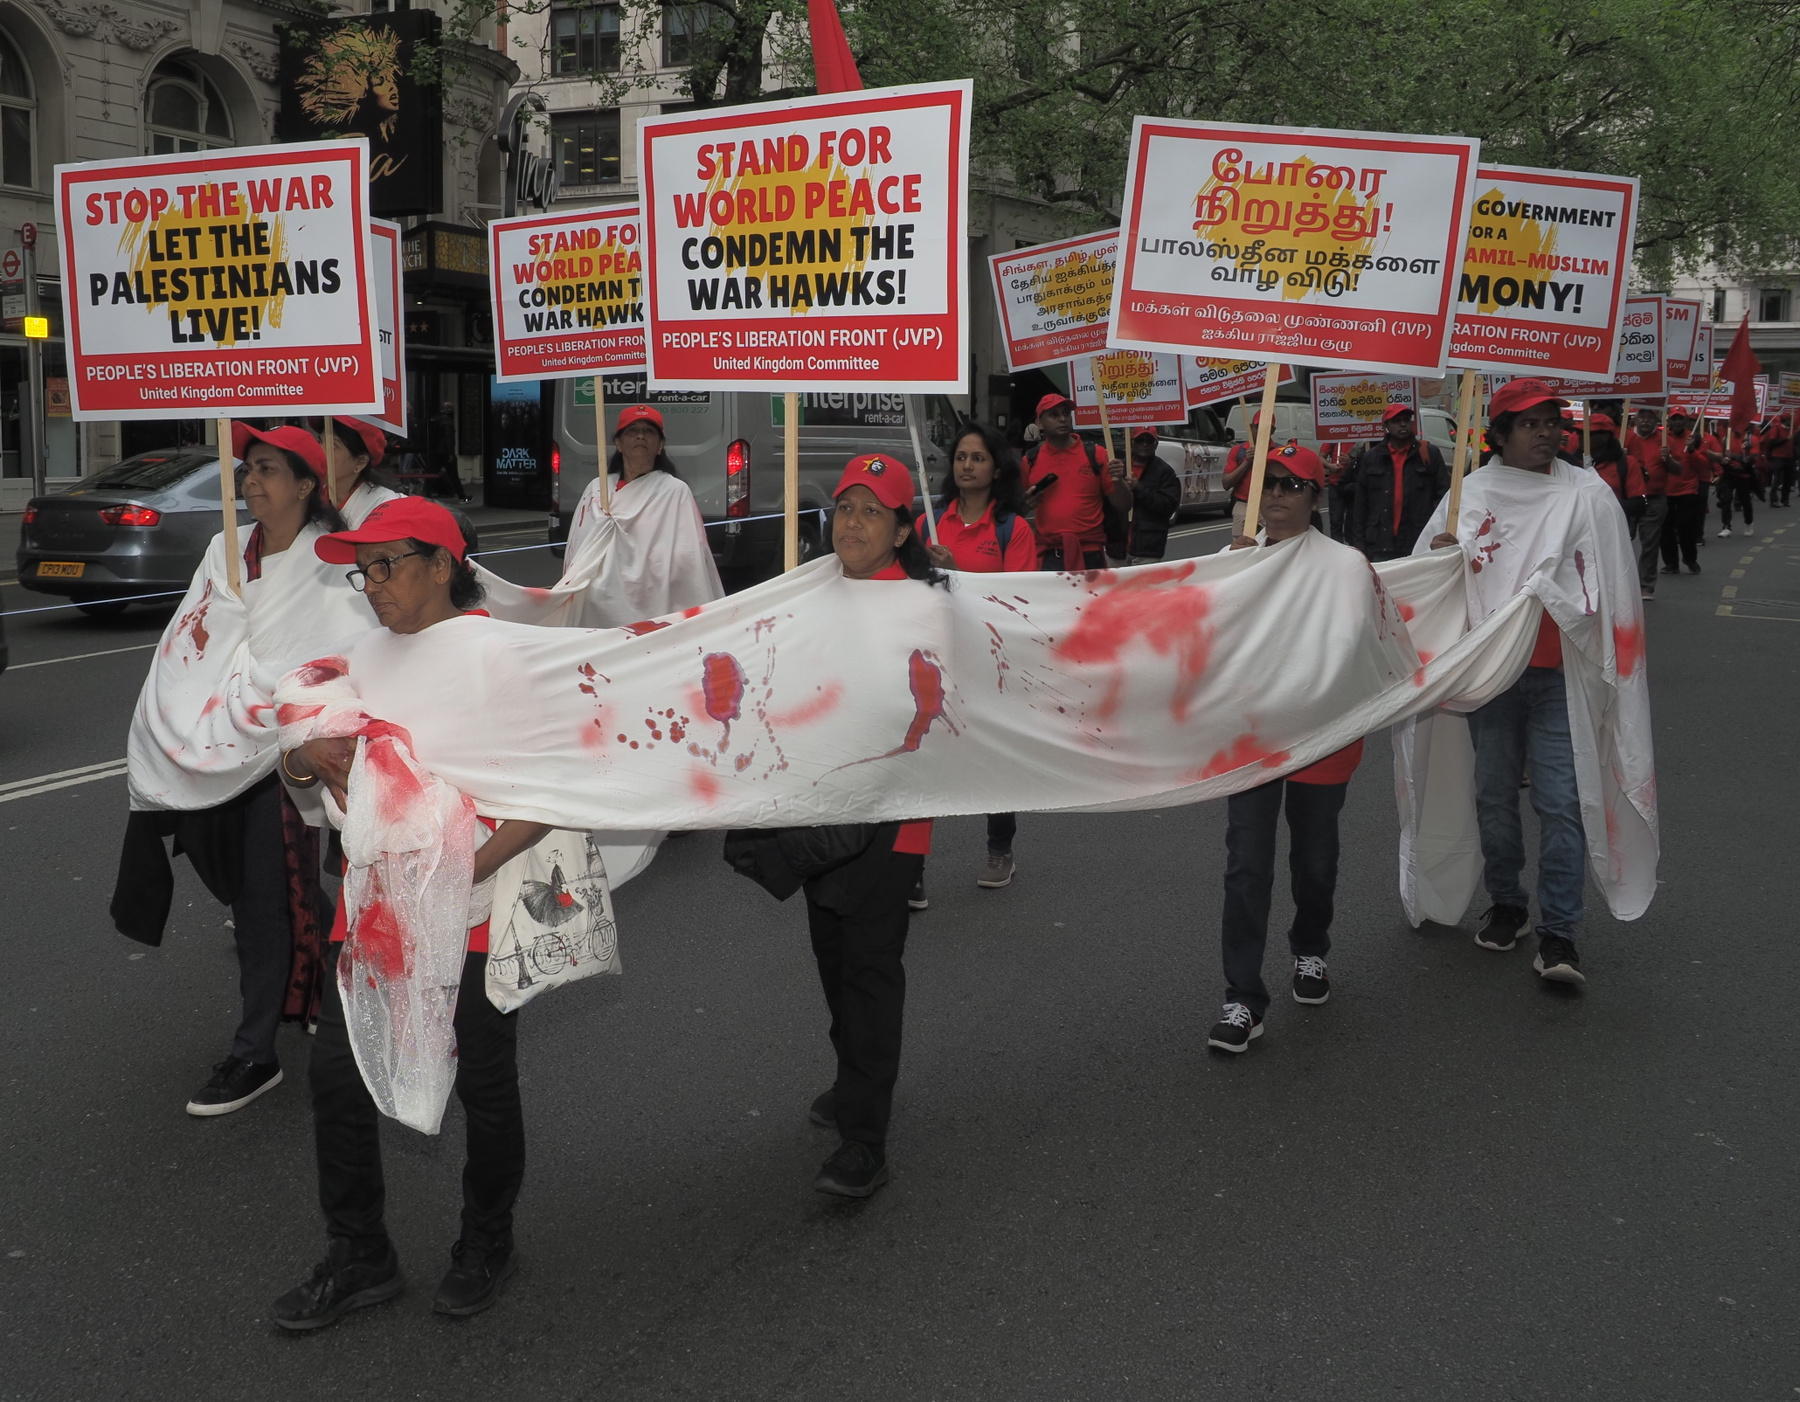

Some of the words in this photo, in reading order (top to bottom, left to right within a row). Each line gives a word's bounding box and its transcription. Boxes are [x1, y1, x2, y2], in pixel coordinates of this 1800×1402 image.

[697, 135, 809, 180] STAND
[819, 126, 892, 170] FOR
[1212, 148, 1388, 201] போரை
[85, 188, 169, 226] STOP
[177, 182, 241, 219] THE
[247, 175, 334, 214] WAR
[673, 185, 795, 229] WORLD
[805, 174, 922, 219] PEACE
[1192, 185, 1395, 242] நிறுத்து!
[1477, 199, 1616, 228] GOVERNMENT
[23, 226, 32, 243] E
[149, 226, 202, 262] LET
[209, 222, 271, 258] THE
[529, 228, 601, 256] STAND
[681, 228, 842, 271] CONDEMN
[850, 224, 915, 262] THE
[1497, 228, 1507, 240] A
[513, 257, 593, 284] WORLD
[600, 251, 641, 275] PEA
[1140, 237, 1298, 268] பாலஸ்தீன
[1305, 245, 1441, 275] மக்களை
[89, 258, 341, 306] PALESTINIANS
[519, 280, 623, 308] CONDEMN
[687, 277, 763, 311] WAR
[770, 269, 907, 308] HAWKS!
[1010, 274, 1052, 292] தேசிய
[1017, 279, 1096, 304] பாதுகாக்கும்
[1210, 265, 1280, 293] வாழ
[1287, 265, 1360, 298] விடு!
[1458, 273, 1584, 314] MONY!
[170, 306, 261, 343] LIVE!
[524, 310, 573, 332] WAR
[578, 302, 645, 327] HAWK
[1131, 301, 1192, 317] மக்கள்
[1195, 304, 1281, 324] விடுதலை
[1391, 320, 1433, 340] (JVP)
[556, 338, 616, 353] LIBERATION
[618, 335, 646, 347] FRON
[736, 329, 826, 348] LIBERATION
[829, 328, 888, 347] FRONT
[892, 326, 943, 350] (JVP)
[1201, 327, 1255, 342] ஐக்கிய
[1320, 340, 1353, 353] குழு
[1453, 323, 1508, 339] RATION
[1511, 327, 1560, 345] FRONT
[1563, 332, 1602, 352] (JVP)
[541, 357, 566, 367] United
[568, 354, 603, 368] Kingdom
[605, 350, 646, 361] Committe
[713, 355, 750, 371] United
[753, 355, 805, 373] Kingdom
[807, 356, 880, 371] Committee
[1488, 345, 1550, 360] Committee
[160, 360, 253, 379] LIBERATION
[257, 358, 309, 376] FRONT
[314, 356, 359, 378] (JVP)
[139, 386, 178, 401] United
[181, 384, 234, 402] Kingdom
[237, 383, 304, 398] Committee
[658, 394, 707, 402] rent-a-car
[691, 406, 709, 414] 227
[864, 413, 904, 424] rent-a-car
[496, 459, 537, 469] MATTER
[502, 448, 530, 458] DARK
